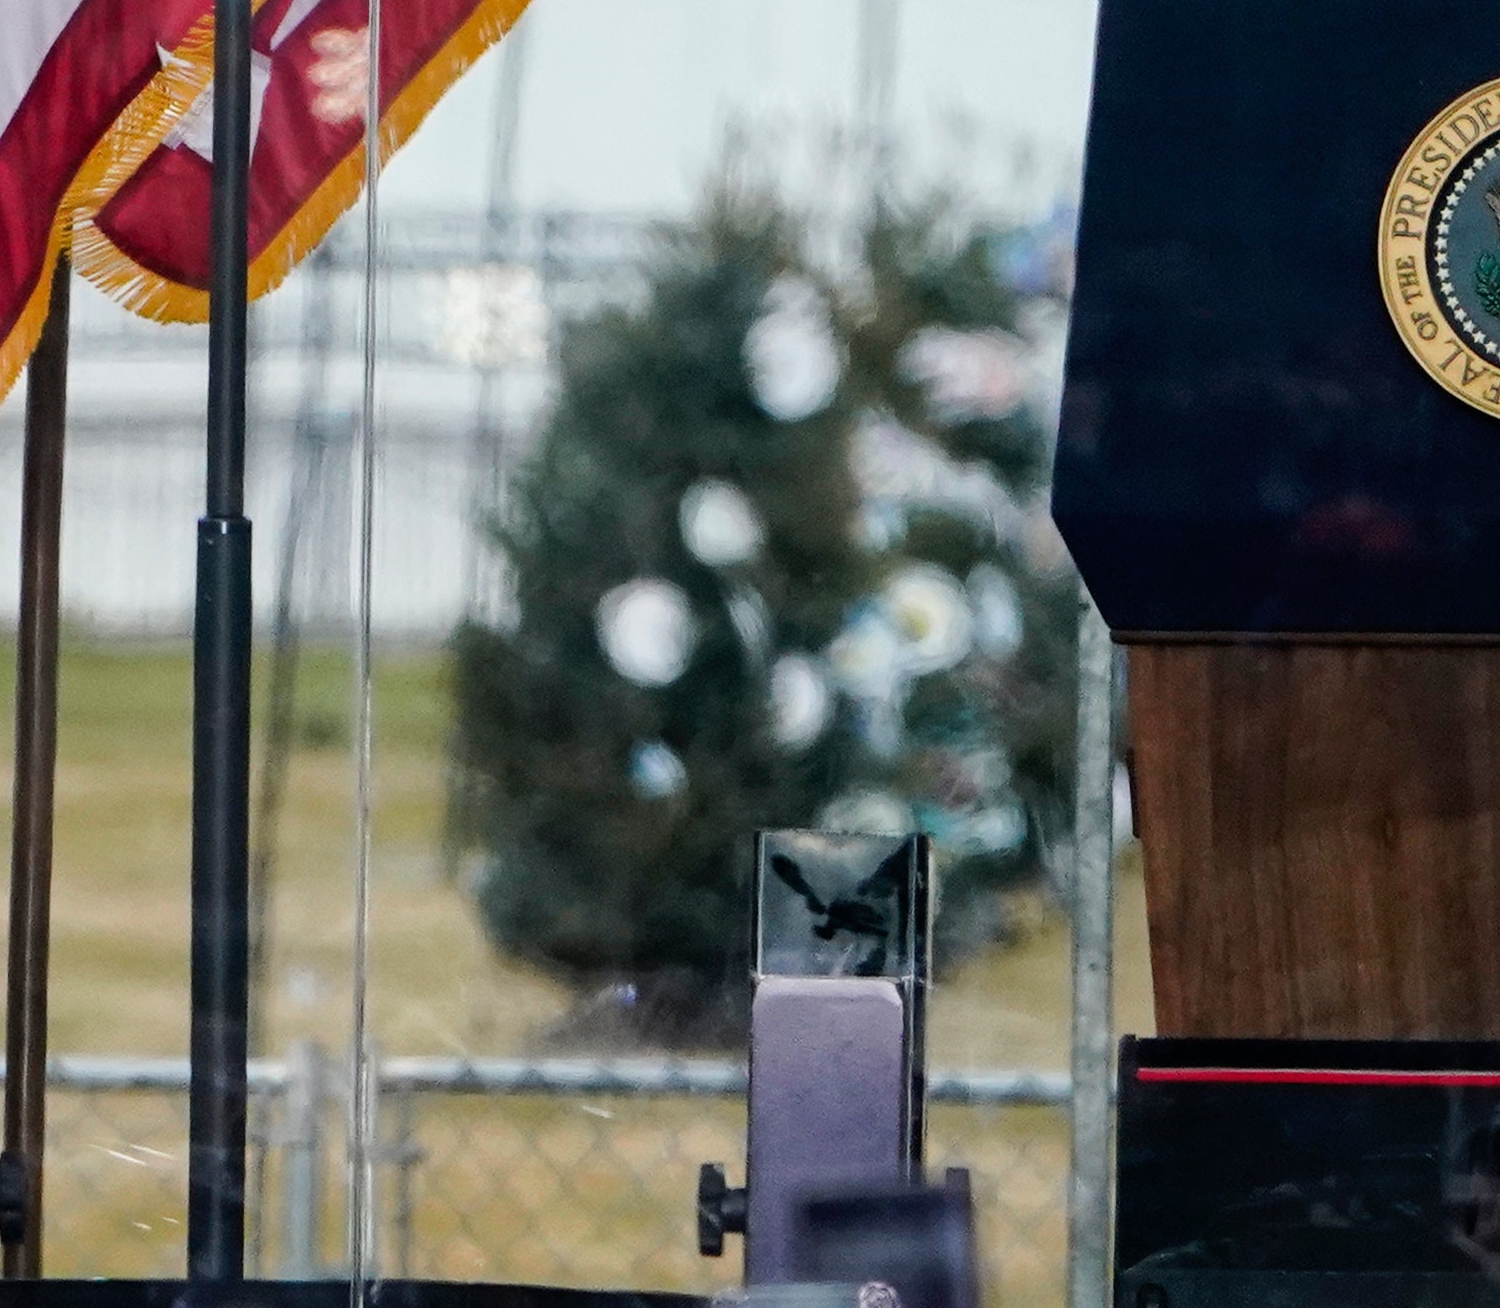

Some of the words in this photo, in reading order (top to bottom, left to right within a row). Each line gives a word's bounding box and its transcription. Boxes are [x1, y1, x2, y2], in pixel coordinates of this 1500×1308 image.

[1392, 93, 1500, 241] PRESIDE
[1395, 255, 1424, 305] THE
[1411, 310, 1438, 341] OF
[1437, 338, 1500, 405] EAL
